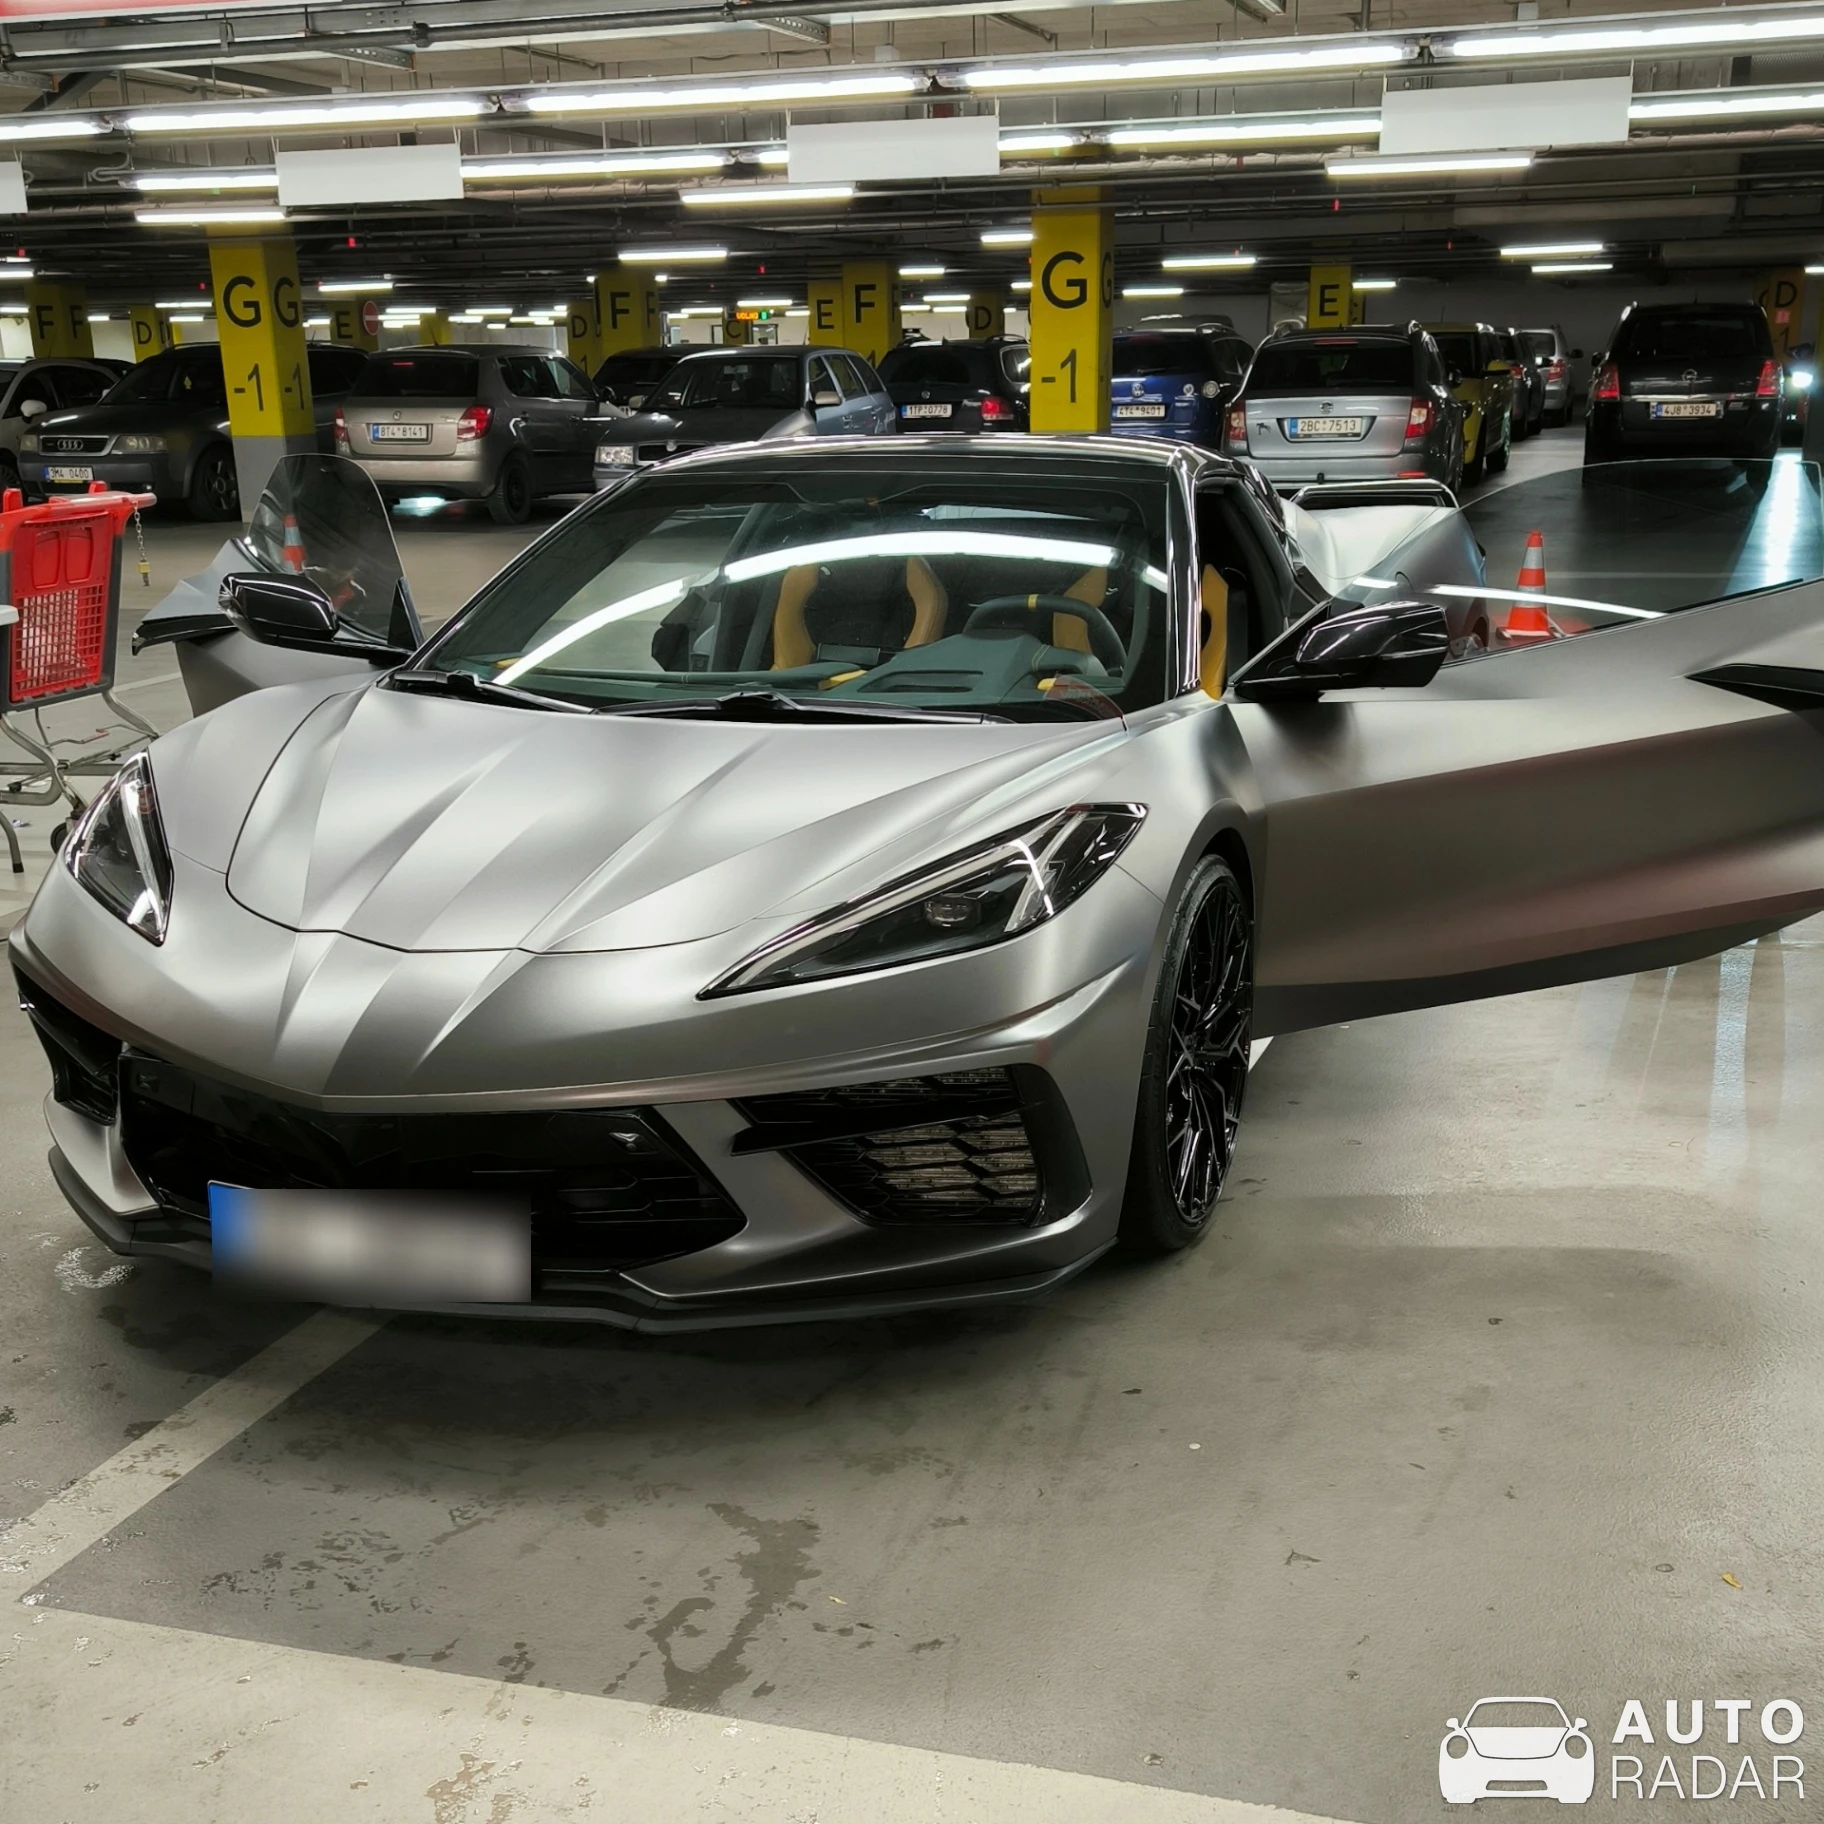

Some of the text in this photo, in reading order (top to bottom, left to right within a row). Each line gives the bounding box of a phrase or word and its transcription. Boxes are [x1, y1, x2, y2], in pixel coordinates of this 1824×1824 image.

[1042, 251, 1087, 309] G
[223, 275, 261, 328] G
[274, 276, 300, 328] G
[610, 291, 630, 329] F
[816, 300, 834, 329] E
[855, 284, 876, 323] F
[1319, 284, 1340, 316] E
[36, 305, 54, 339] F
[69, 305, 83, 339] F
[136, 321, 152, 344] D
[335, 311, 352, 339] E
[571, 315, 587, 338] D
[975, 306, 992, 330] D
[234, 363, 264, 412] -1
[1041, 348, 1077, 403] -1
